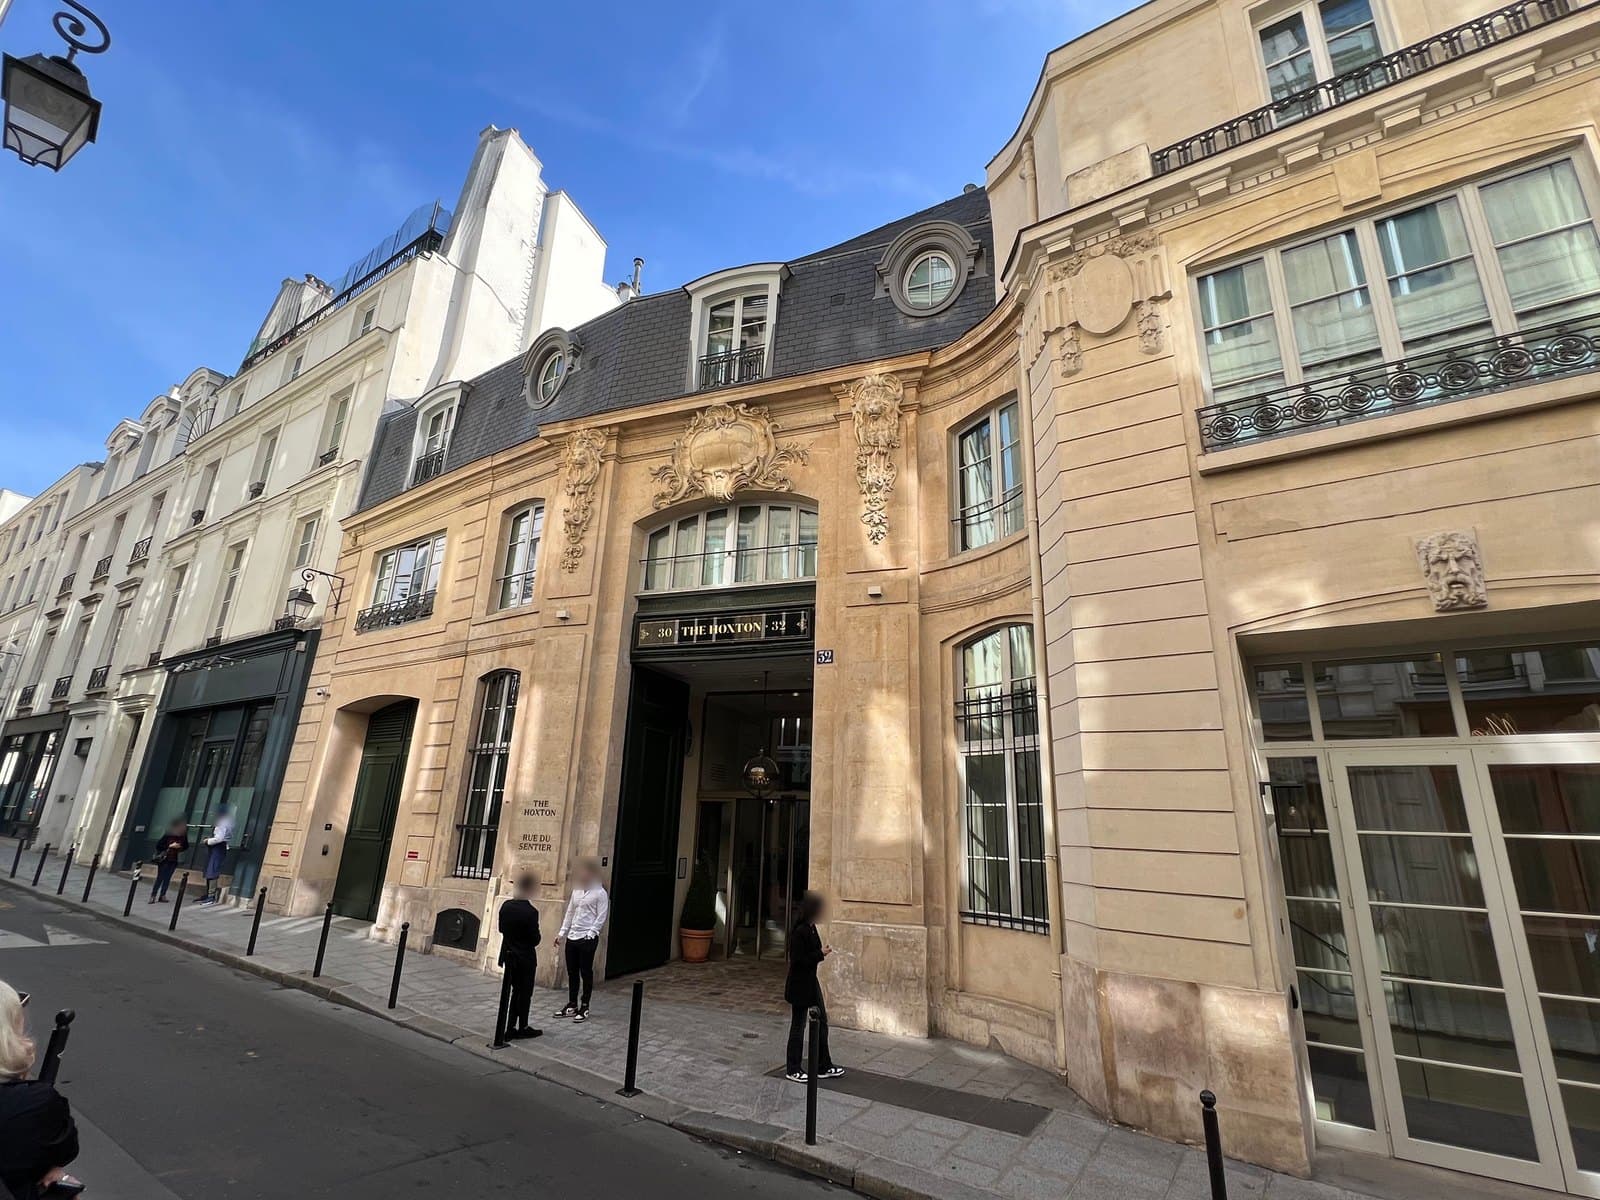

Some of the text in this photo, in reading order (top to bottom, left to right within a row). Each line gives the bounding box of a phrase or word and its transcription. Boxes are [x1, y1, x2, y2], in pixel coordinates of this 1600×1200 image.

[658, 620, 786, 637] 30 THE HOXTON 32
[817, 650, 832, 663] 32
[523, 808, 556, 816] HOXTON
[522, 834, 551, 842] RUE DU
[518, 843, 552, 851] SENTIER
